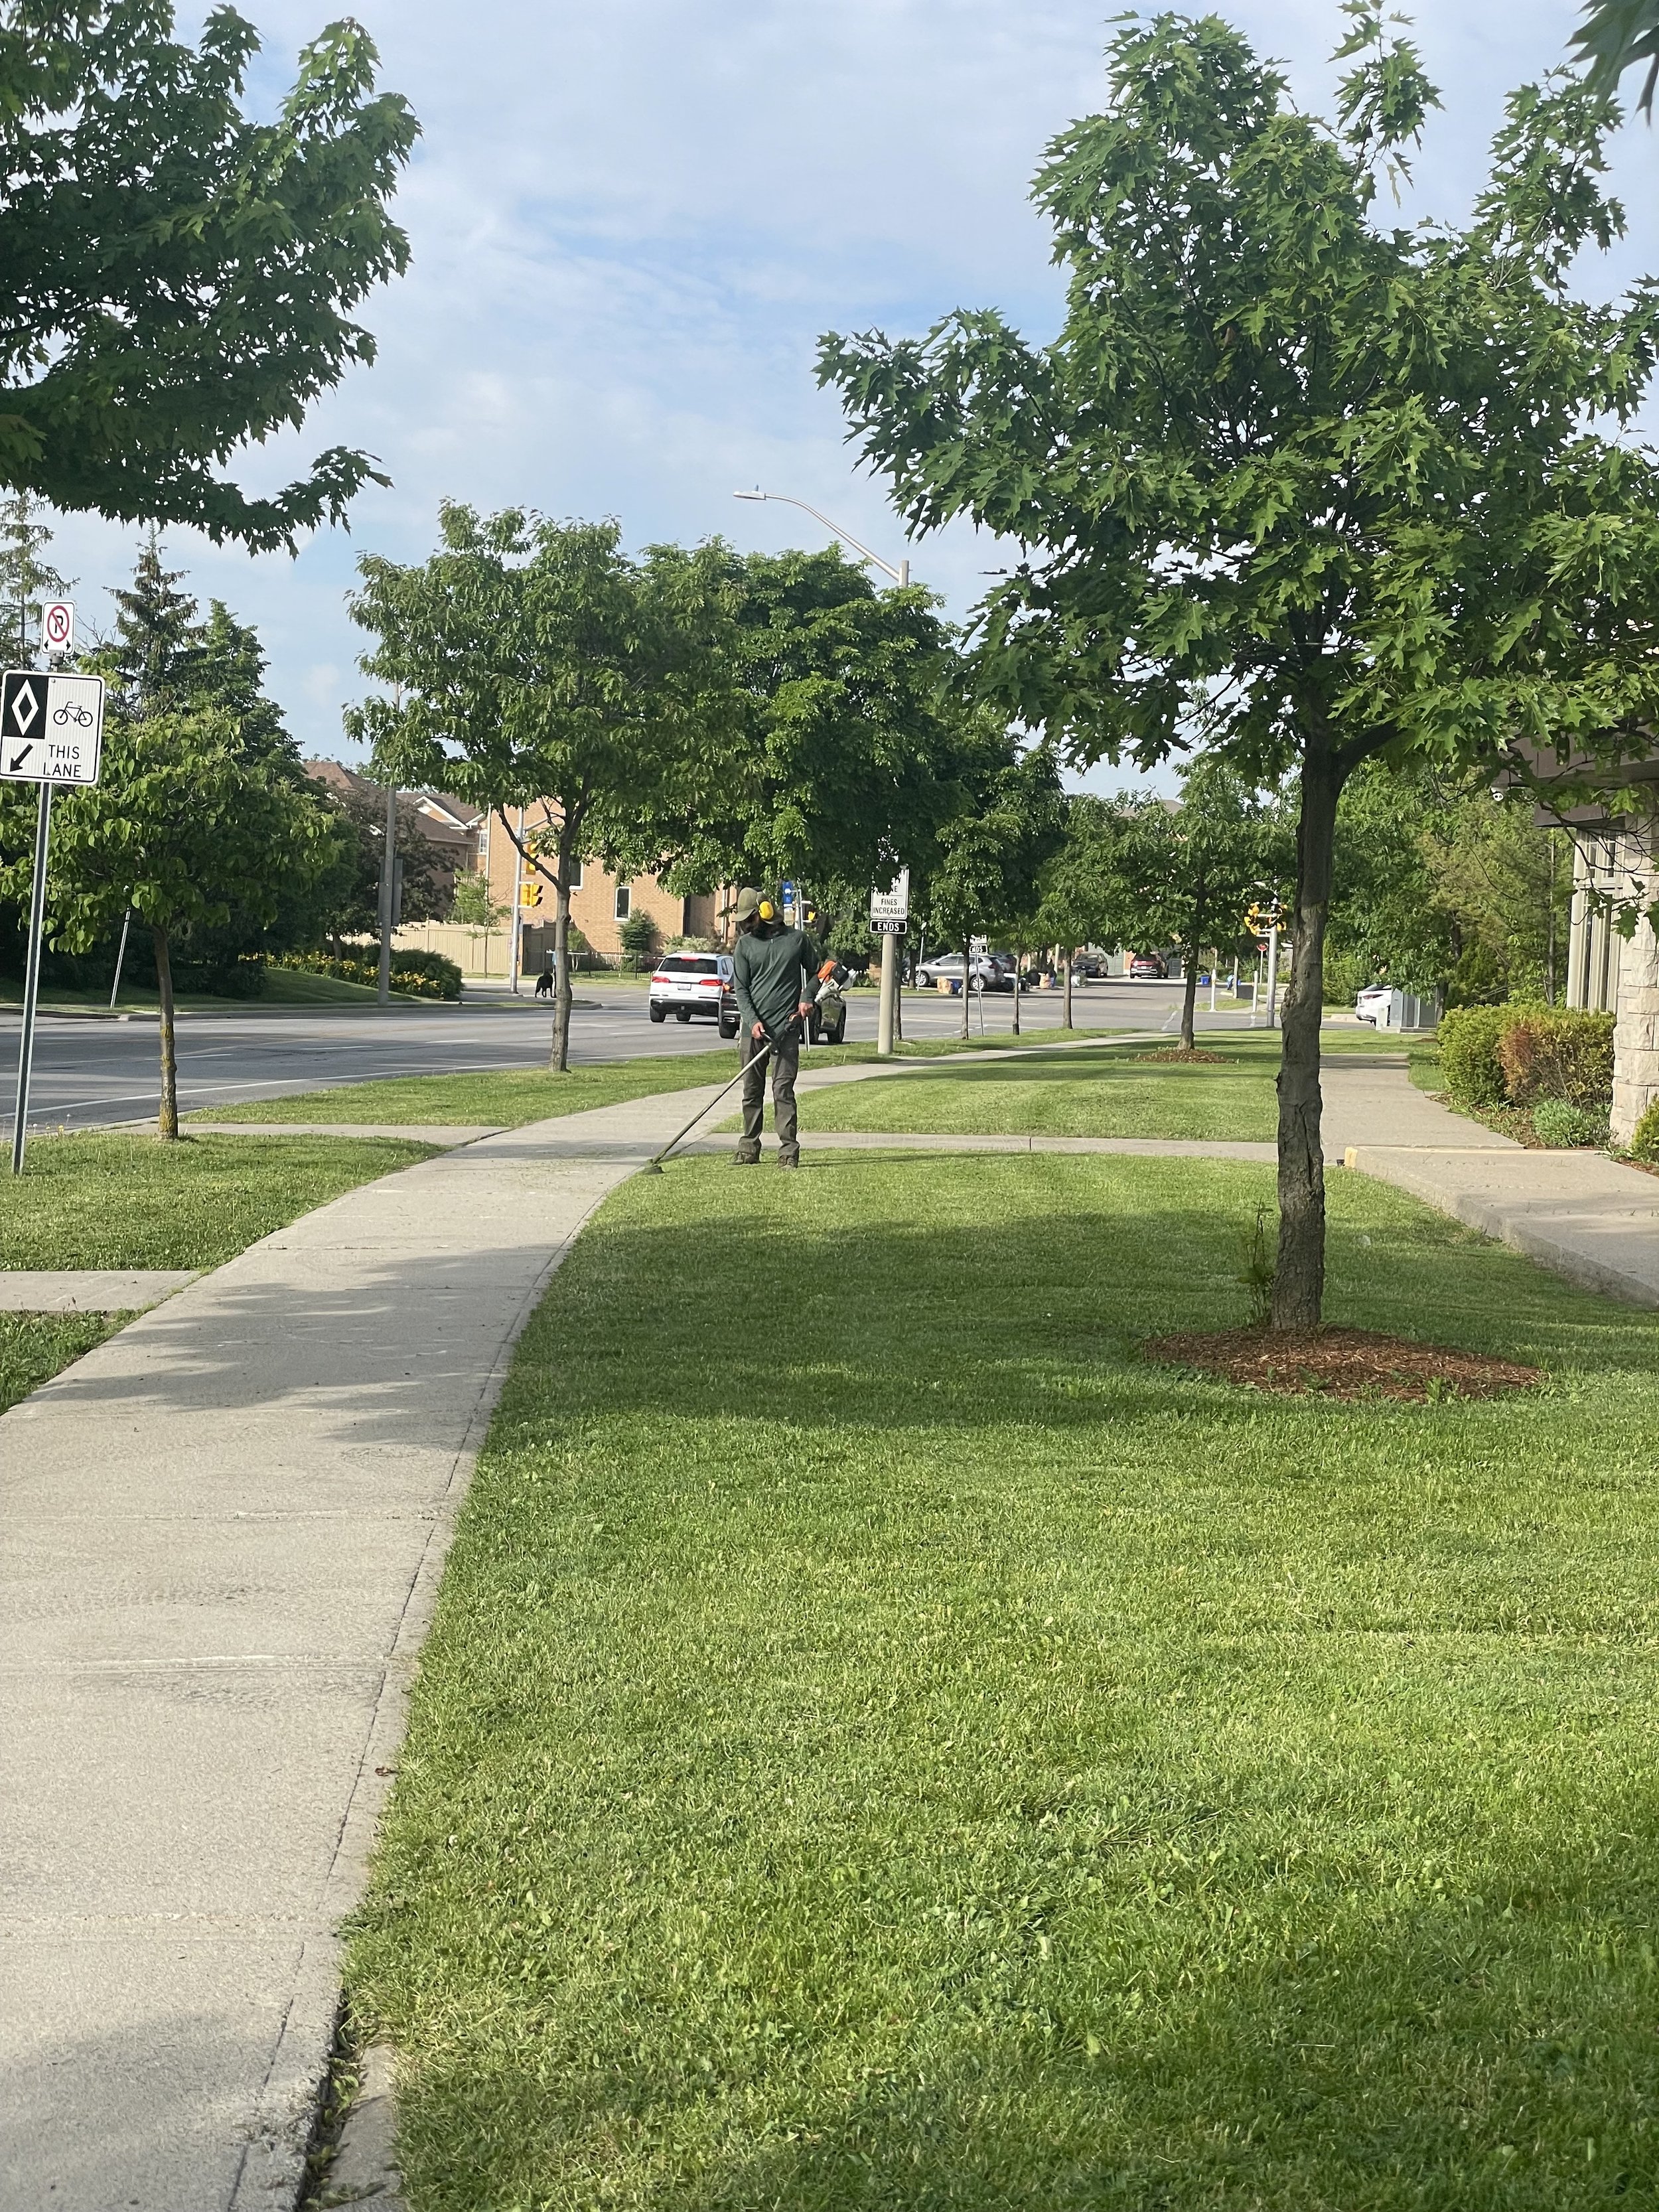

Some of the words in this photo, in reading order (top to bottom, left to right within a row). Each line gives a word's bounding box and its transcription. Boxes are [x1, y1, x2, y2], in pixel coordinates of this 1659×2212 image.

[48, 744, 80, 759] THIS
[43, 762, 82, 778] LANE
[877, 922, 899, 931] ENDS
